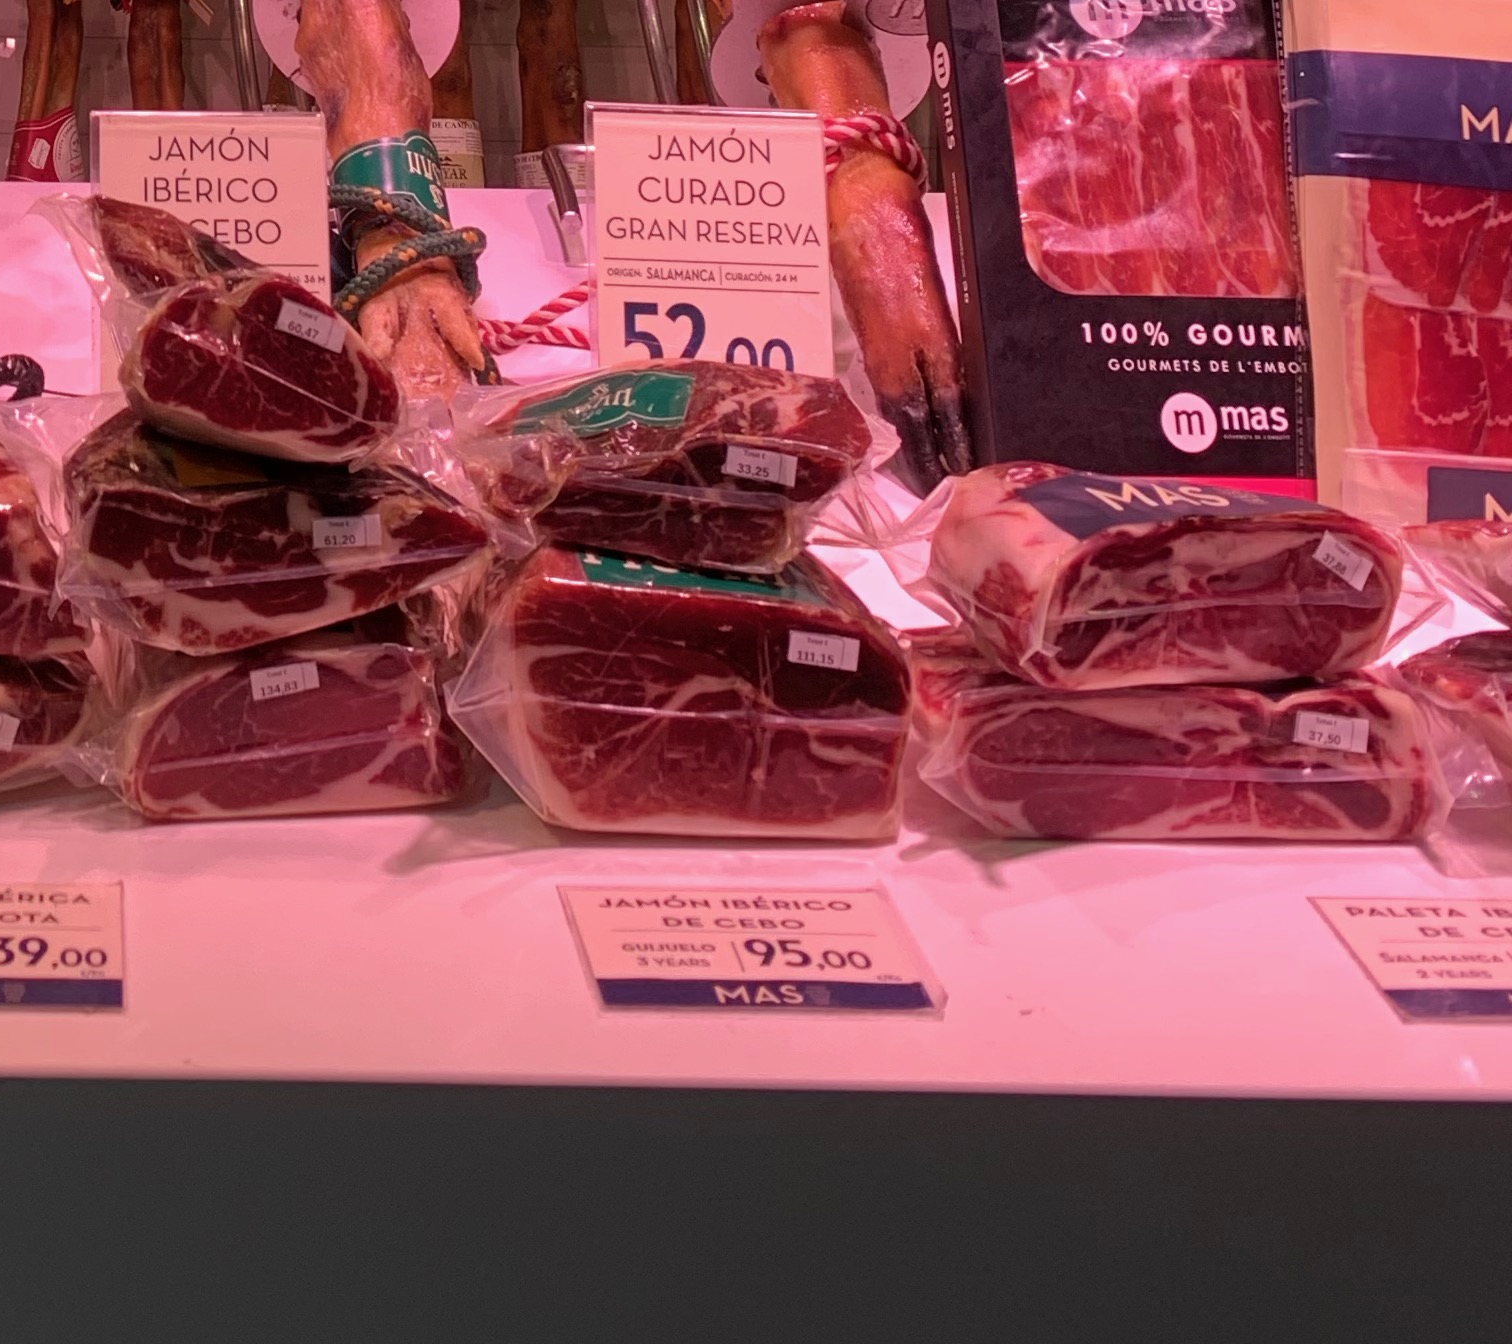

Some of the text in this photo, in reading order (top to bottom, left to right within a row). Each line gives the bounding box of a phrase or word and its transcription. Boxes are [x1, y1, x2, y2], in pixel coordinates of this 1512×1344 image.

[149, 128, 269, 162] JAMÓN
[649, 128, 770, 163] JAMÓN
[143, 170, 278, 203] IBÉRICO
[638, 177, 785, 207] CURADO
[606, 217, 821, 247] GRAN RESERVA
[646, 266, 716, 283] SALAMANCA
[1081, 321, 1170, 347] 100%
[1107, 358, 1230, 373] GOURMETS DE
[1221, 406, 1288, 432] mas
[737, 461, 770, 478] 33,25
[598, 895, 853, 912] JAMÓN IBÉRICO
[713, 917, 806, 930] CEBO
[744, 939, 872, 971] 95,00
[713, 984, 805, 1006] MAS
